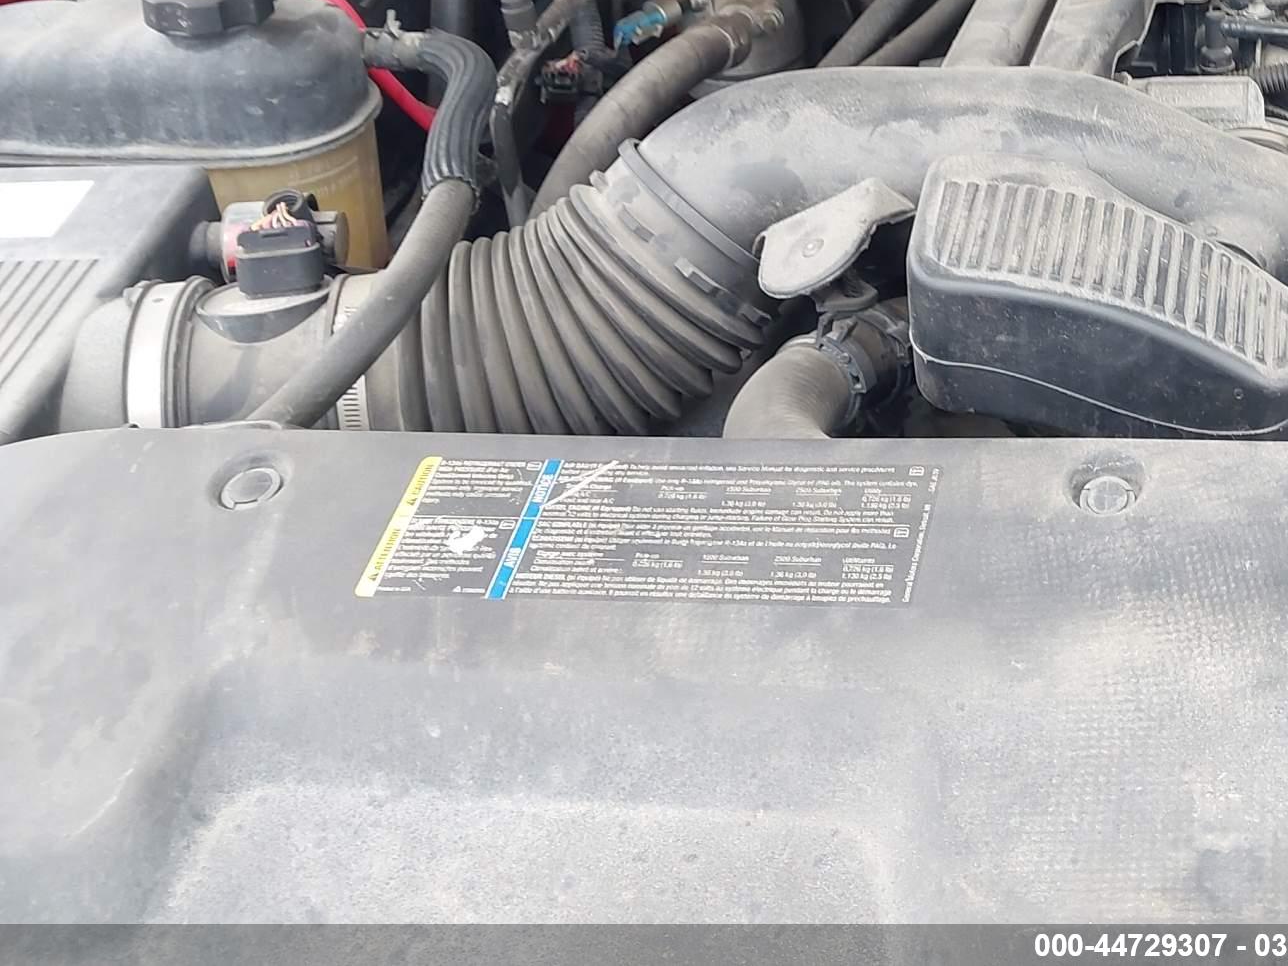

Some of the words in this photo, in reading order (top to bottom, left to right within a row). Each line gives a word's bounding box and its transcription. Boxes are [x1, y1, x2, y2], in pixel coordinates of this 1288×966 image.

[413, 464, 434, 496] CAUTION
[533, 474, 554, 503] NOTICE
[374, 528, 400, 571] ATTENTION
[504, 546, 522, 568] AVIS
